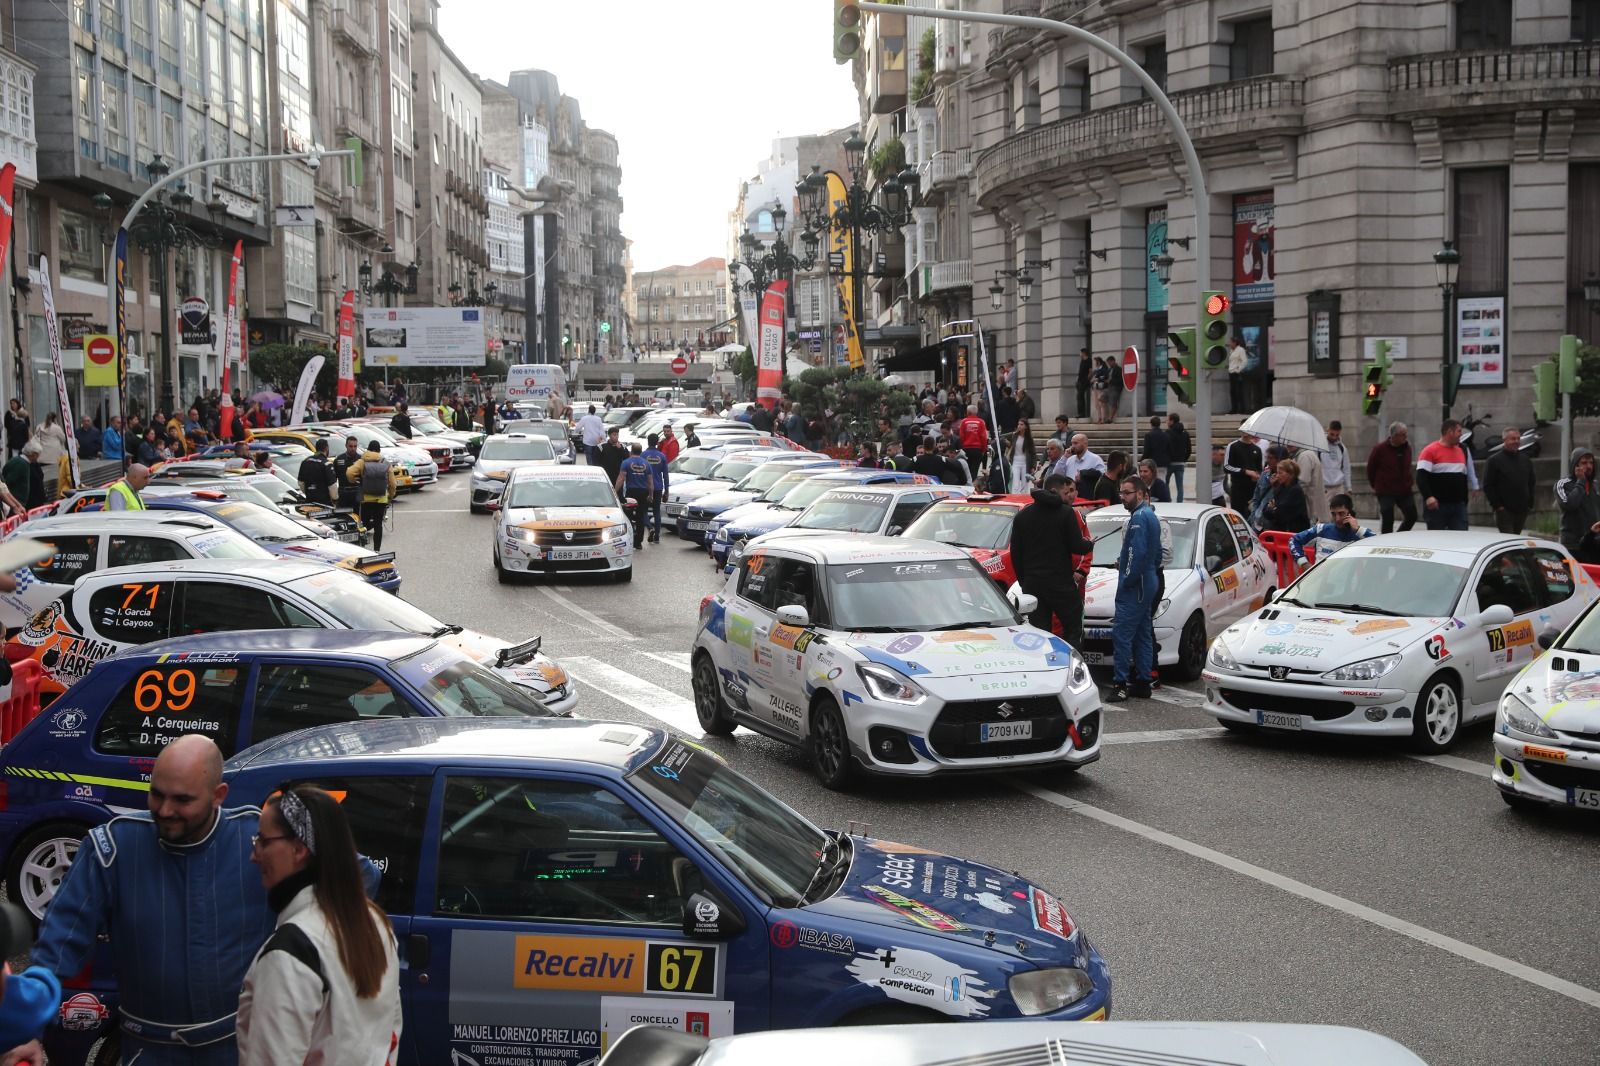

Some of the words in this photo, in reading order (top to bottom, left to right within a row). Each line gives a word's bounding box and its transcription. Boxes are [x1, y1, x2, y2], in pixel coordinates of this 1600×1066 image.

[764, 328, 772, 366] CONCELLO
[772, 353, 778, 363] DE
[67, 553, 89, 561] CENTENO
[553, 551, 573, 559] 4689
[121, 583, 160, 609] 71
[123, 619, 154, 629] Gayoso
[1488, 630, 1503, 651] 72
[1506, 625, 1532, 643] Recalvi
[945, 665, 961, 673] TE
[974, 661, 1025, 670] QUIERO
[134, 668, 197, 712] 69
[981, 681, 1028, 691] BRUNO
[769, 694, 803, 719] TALLERES
[142, 716, 153, 728] A.
[156, 717, 220, 731] Cerqueiras
[772, 710, 800, 731] RAMOS
[140, 732, 151, 745] D.
[988, 725, 1011, 738] 2709
[1013, 724, 1031, 736] KVJ
[1524, 745, 1566, 761] PIRELLI
[799, 926, 855, 953] IBASA
[525, 949, 635, 980] Recalvi
[659, 947, 703, 991] 67
[894, 966, 932, 982] RALLY
[630, 1014, 679, 1025] CONCELLO
[454, 1024, 493, 1040] MANUEL
[494, 1027, 539, 1043] LORENZO
[541, 1029, 569, 1044] PEREZ
[571, 1030, 598, 1046] LAGO
[470, 1044, 533, 1057] CONSTRUCCIONES,
[534, 1046, 581, 1059] TRANSPORTE,
[484, 1056, 535, 1066] EXCAVACIONES
